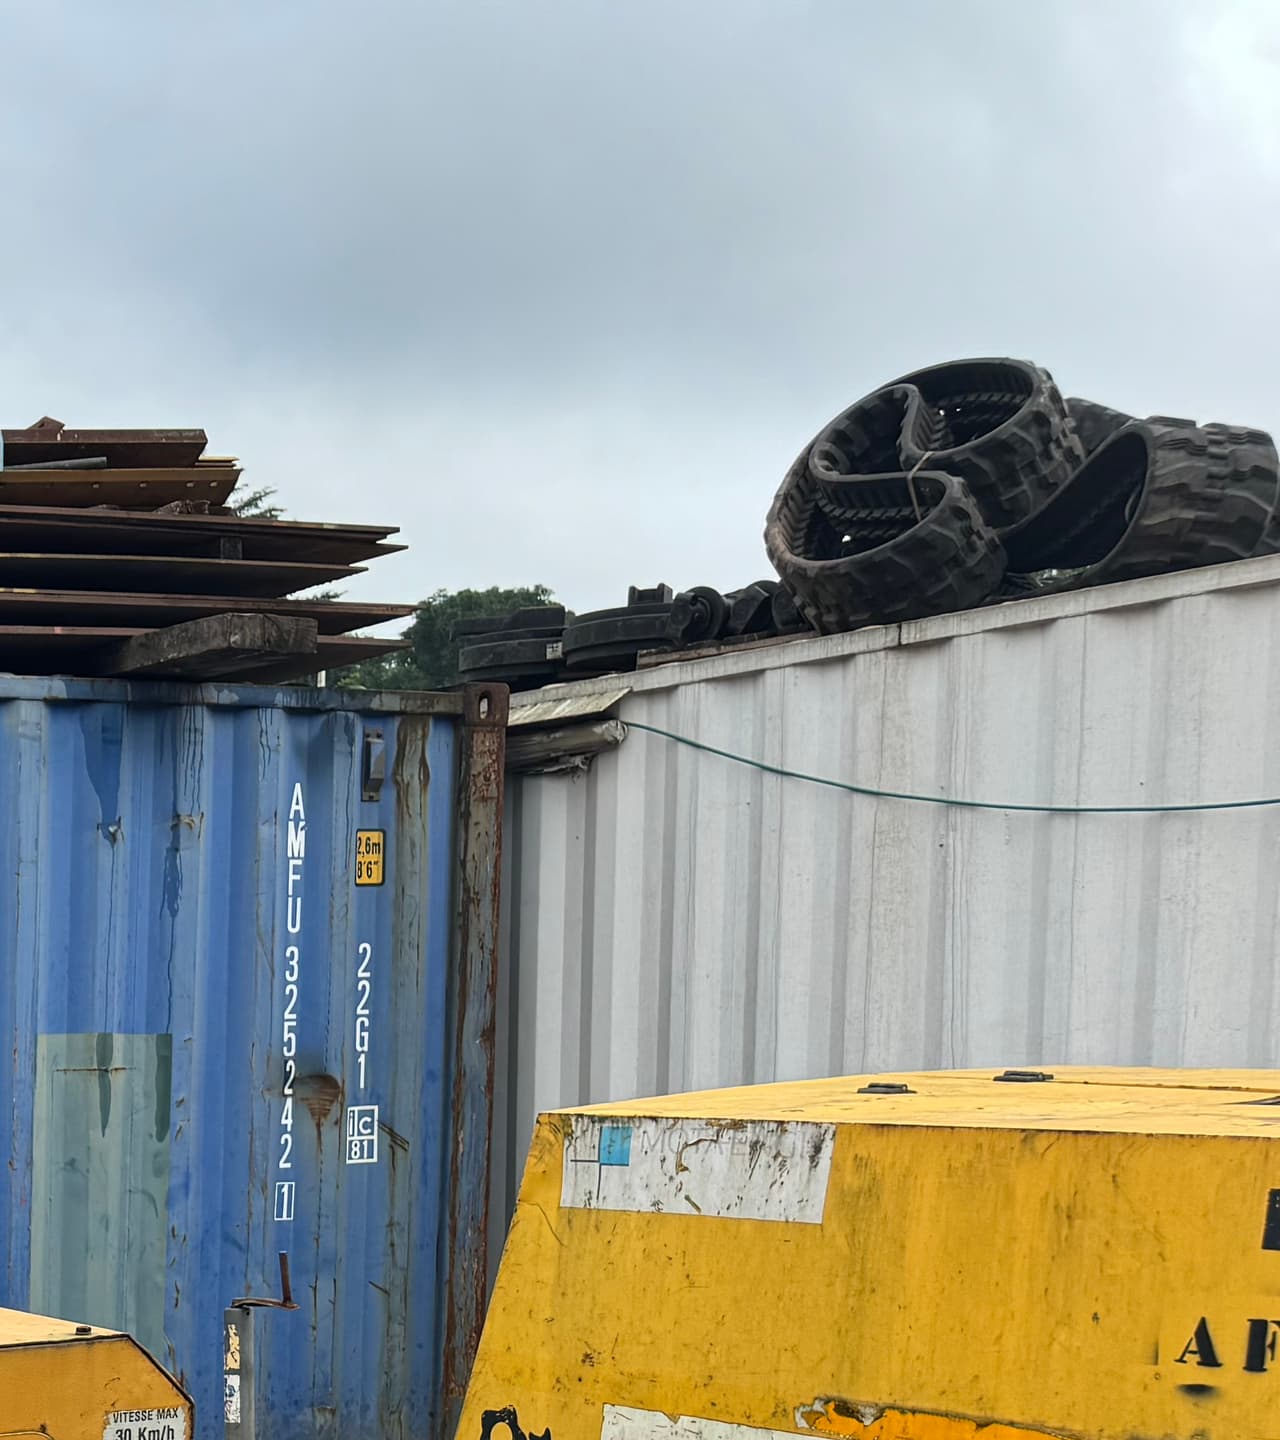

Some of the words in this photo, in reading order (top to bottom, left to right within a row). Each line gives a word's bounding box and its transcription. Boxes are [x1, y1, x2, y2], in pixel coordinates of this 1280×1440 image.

[288, 782, 306, 934] AMFU
[355, 942, 372, 1089] 22G1
[350, 1140, 369, 1160] 81
[112, 1410, 153, 1424] VITESSE
[156, 1407, 179, 1420] MAX
